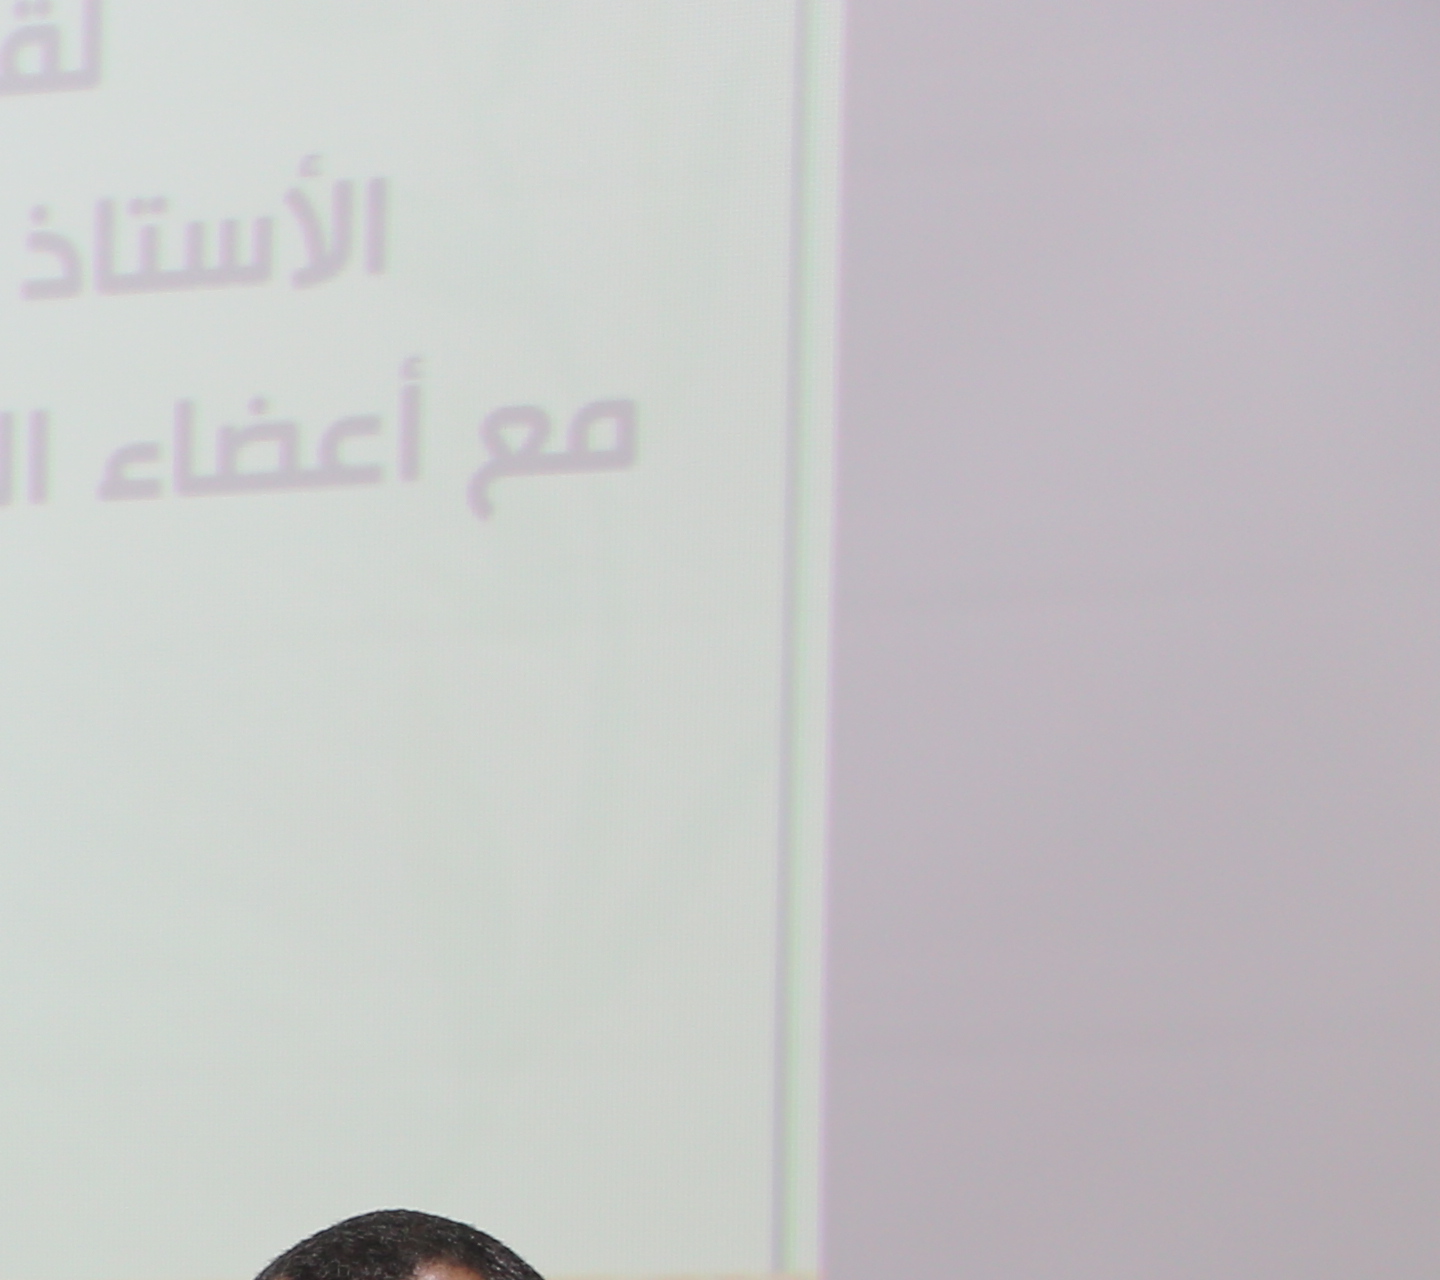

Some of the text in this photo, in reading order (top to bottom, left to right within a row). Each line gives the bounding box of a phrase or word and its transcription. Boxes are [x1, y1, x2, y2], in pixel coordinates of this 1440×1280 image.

[16, 151, 393, 304] الأستاذ
[92, 352, 425, 505] أعضاء
[463, 393, 642, 526] مع
